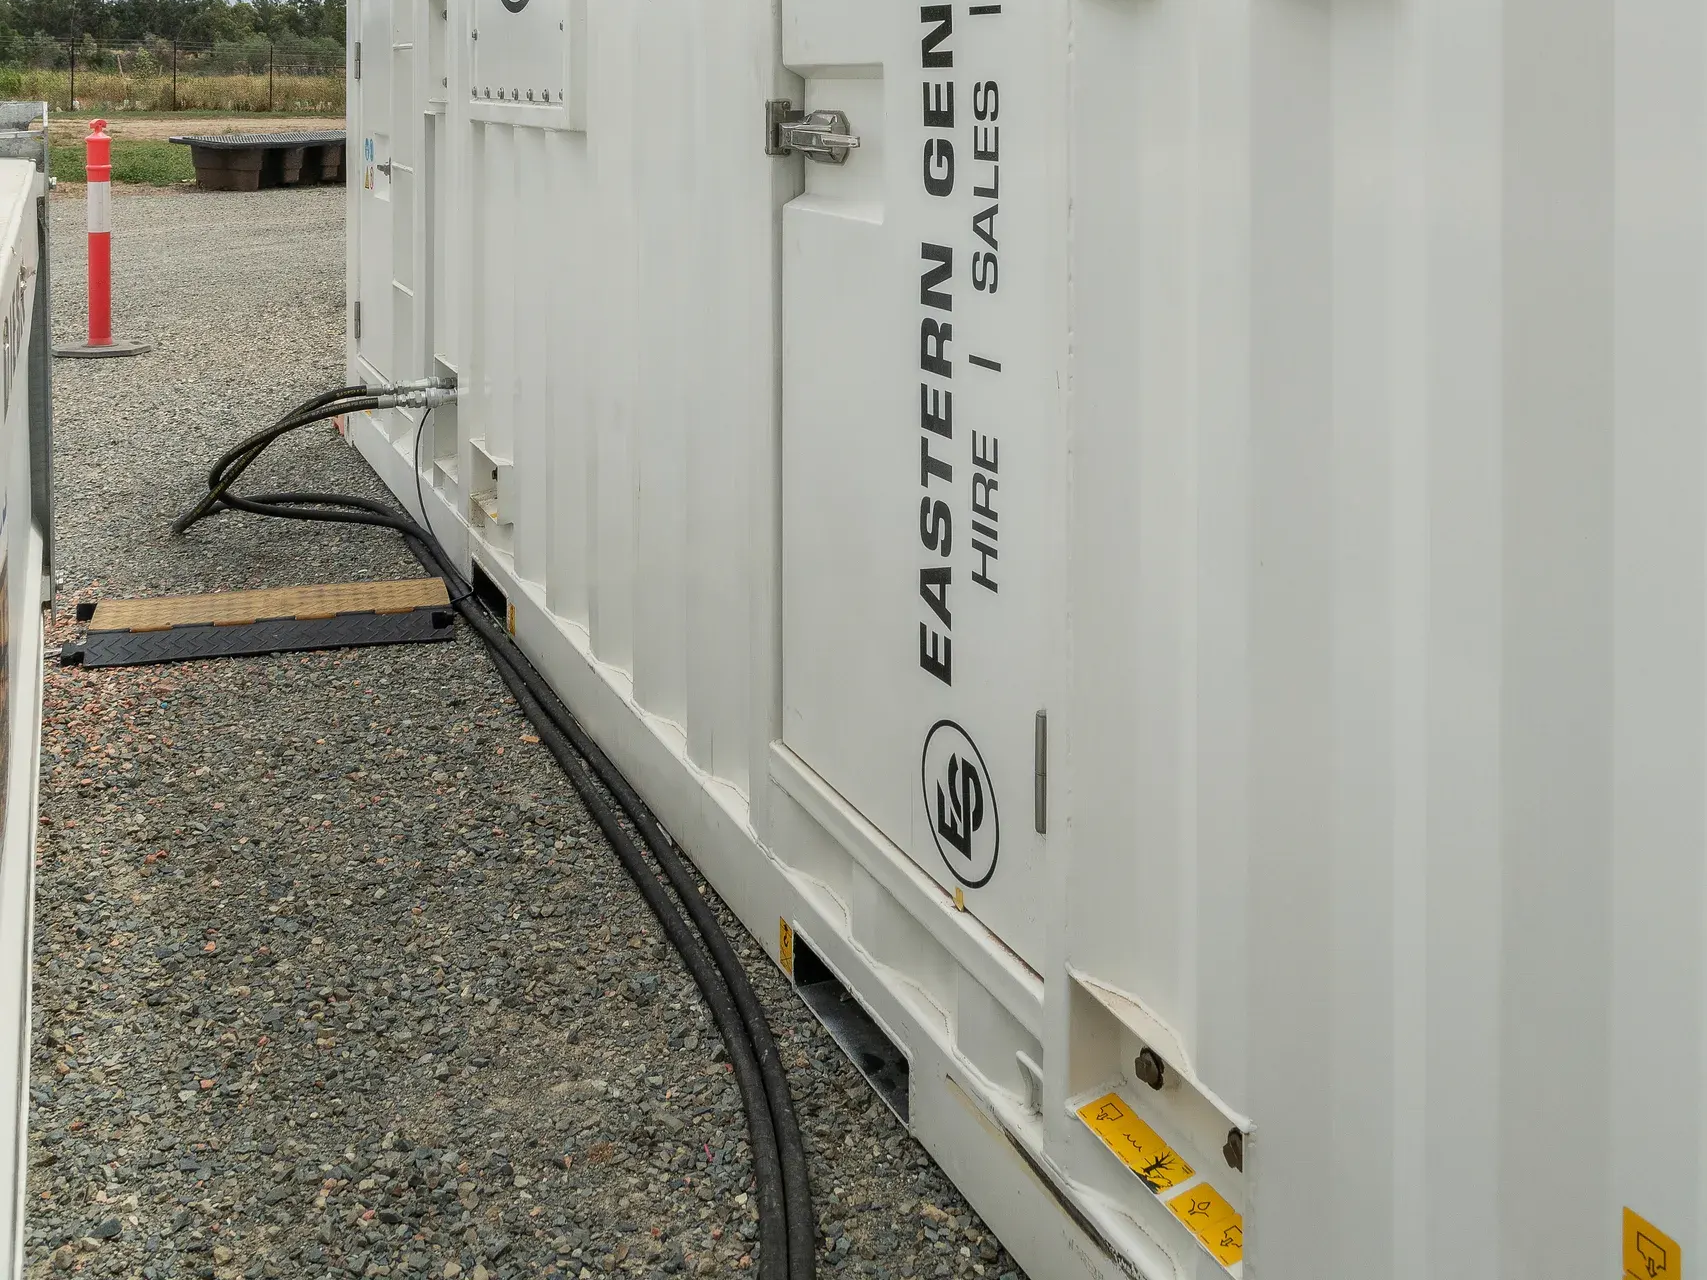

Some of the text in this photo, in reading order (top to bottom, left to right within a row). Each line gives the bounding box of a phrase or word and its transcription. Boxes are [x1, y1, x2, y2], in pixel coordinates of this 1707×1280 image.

[972, 80, 1000, 294] SALES
[920, 241, 953, 688] EASTERN
[971, 429, 999, 594] HIRE
